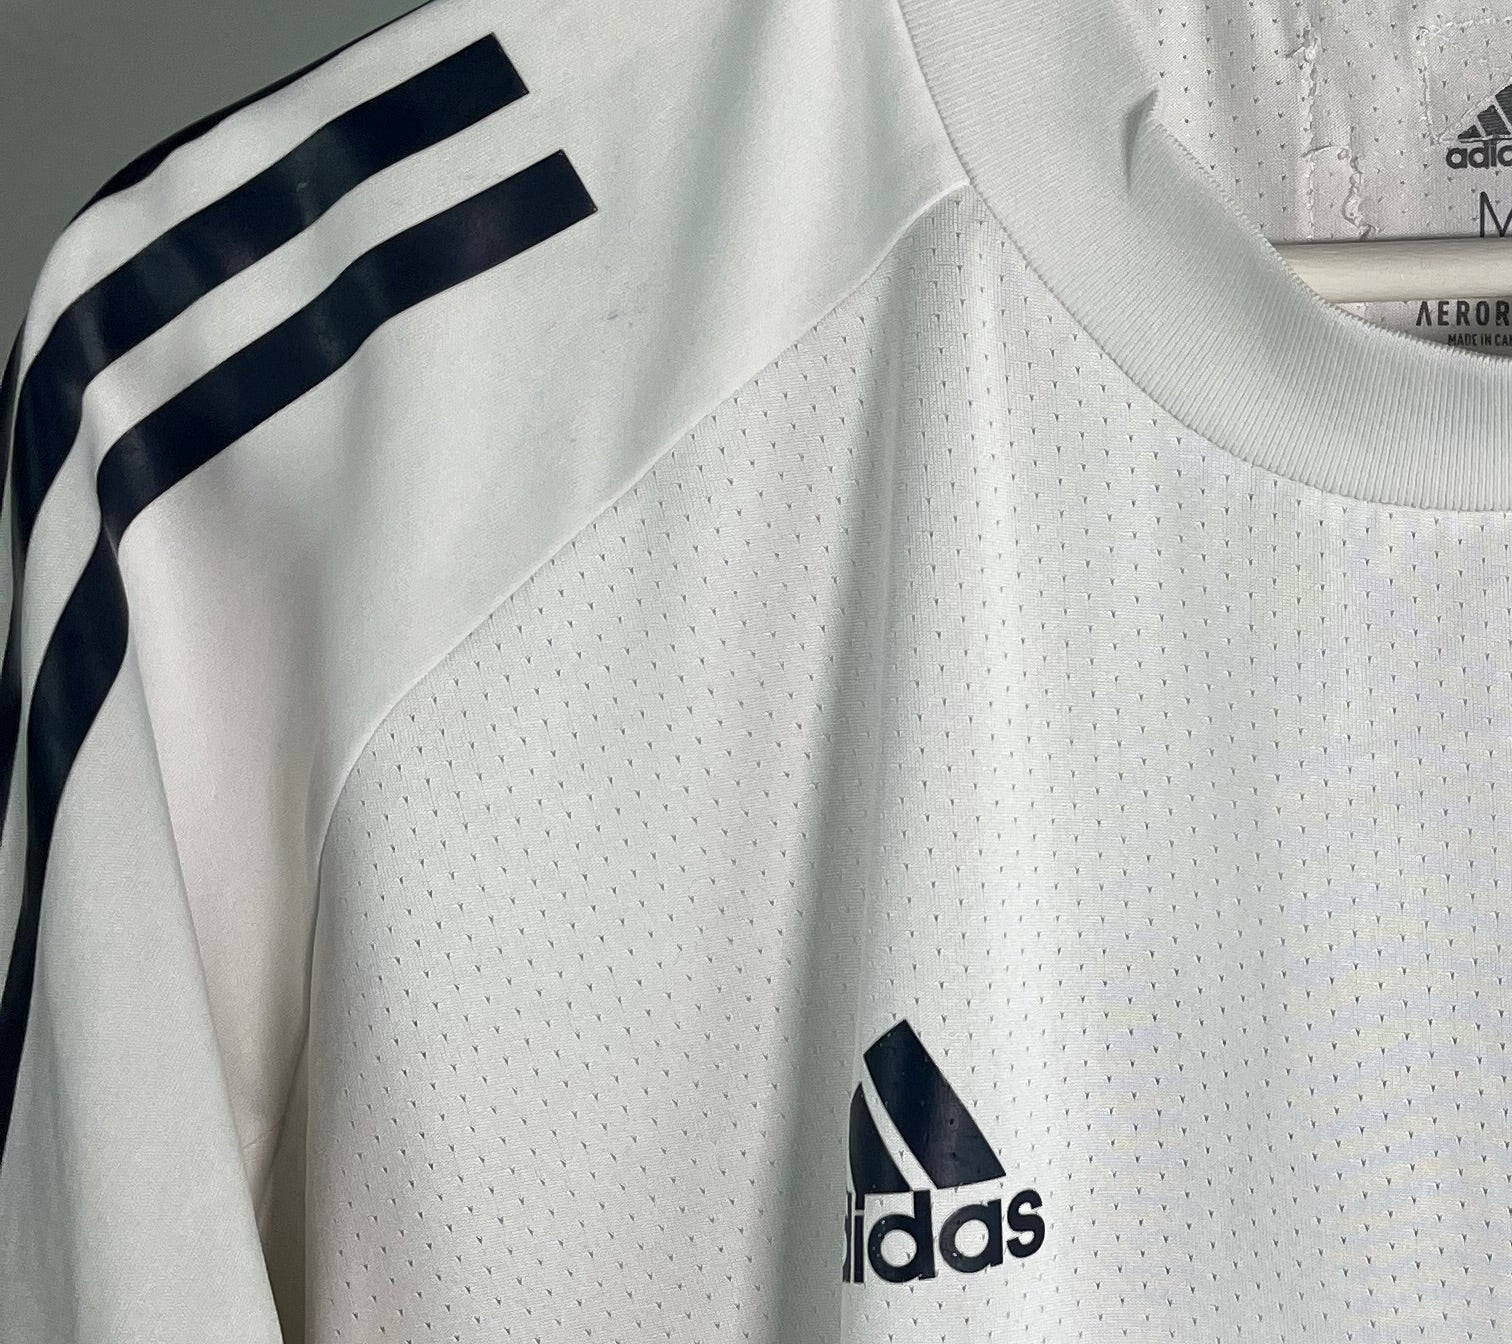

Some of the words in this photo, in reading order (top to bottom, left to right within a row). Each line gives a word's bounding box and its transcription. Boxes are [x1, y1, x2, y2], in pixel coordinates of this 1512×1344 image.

[1447, 333, 1479, 347] MADE
[1480, 333, 1493, 347] IN
[843, 1189, 1045, 1283] idas
